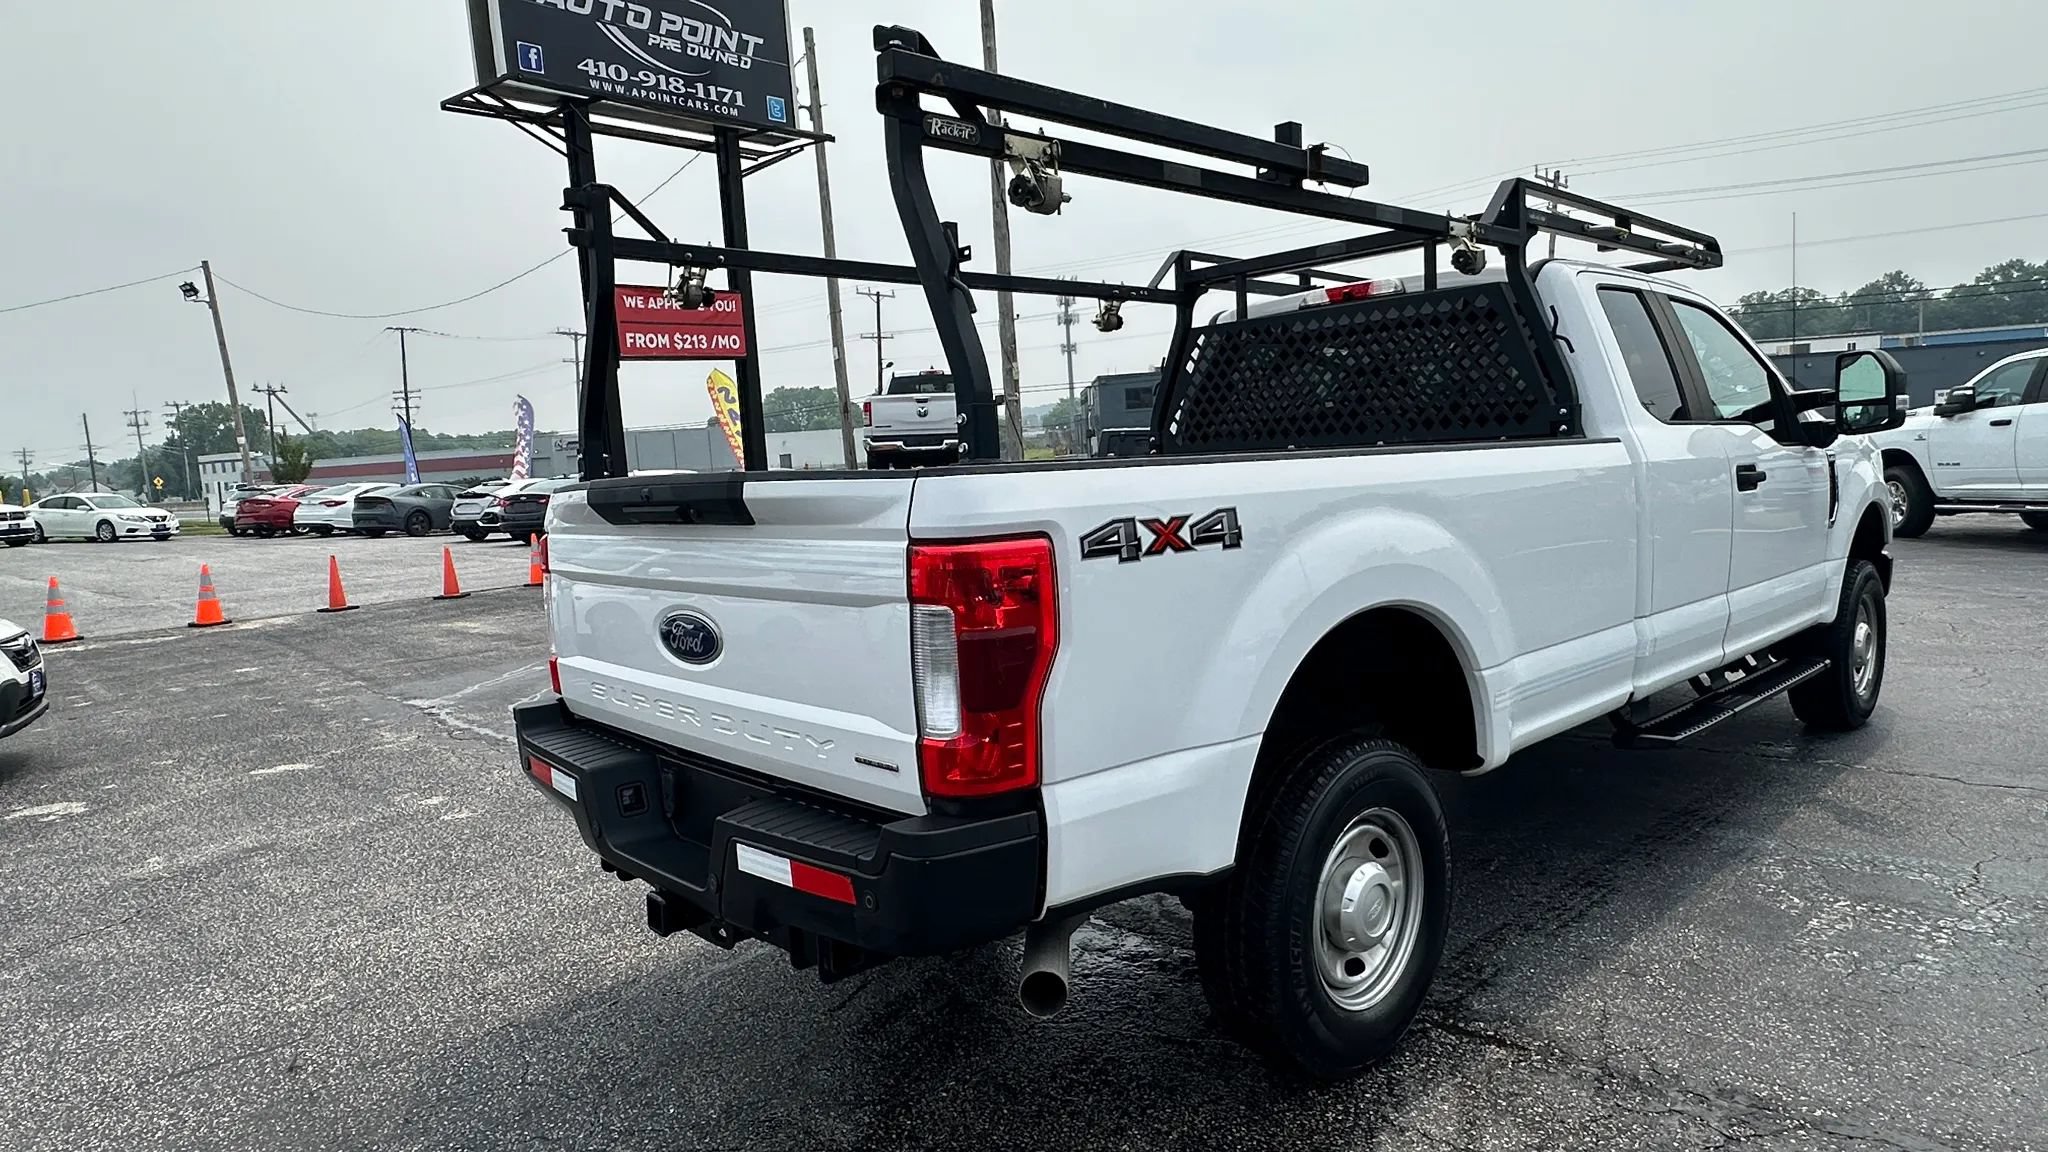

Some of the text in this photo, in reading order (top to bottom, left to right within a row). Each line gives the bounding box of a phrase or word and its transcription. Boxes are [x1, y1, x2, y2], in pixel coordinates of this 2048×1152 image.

[536, 0, 764, 57] UTO POINT
[648, 33, 752, 70] PRE OWNED
[577, 58, 746, 107] 410-918-1171
[589, 78, 739, 117] WWW.APOINTCARS.COM
[623, 295, 645, 309] WE
[709, 299, 737, 313] OU!
[625, 331, 741, 351] FROM $213 /MO
[670, 620, 704, 652] Ford
[591, 681, 835, 759] SUPER DUTY
